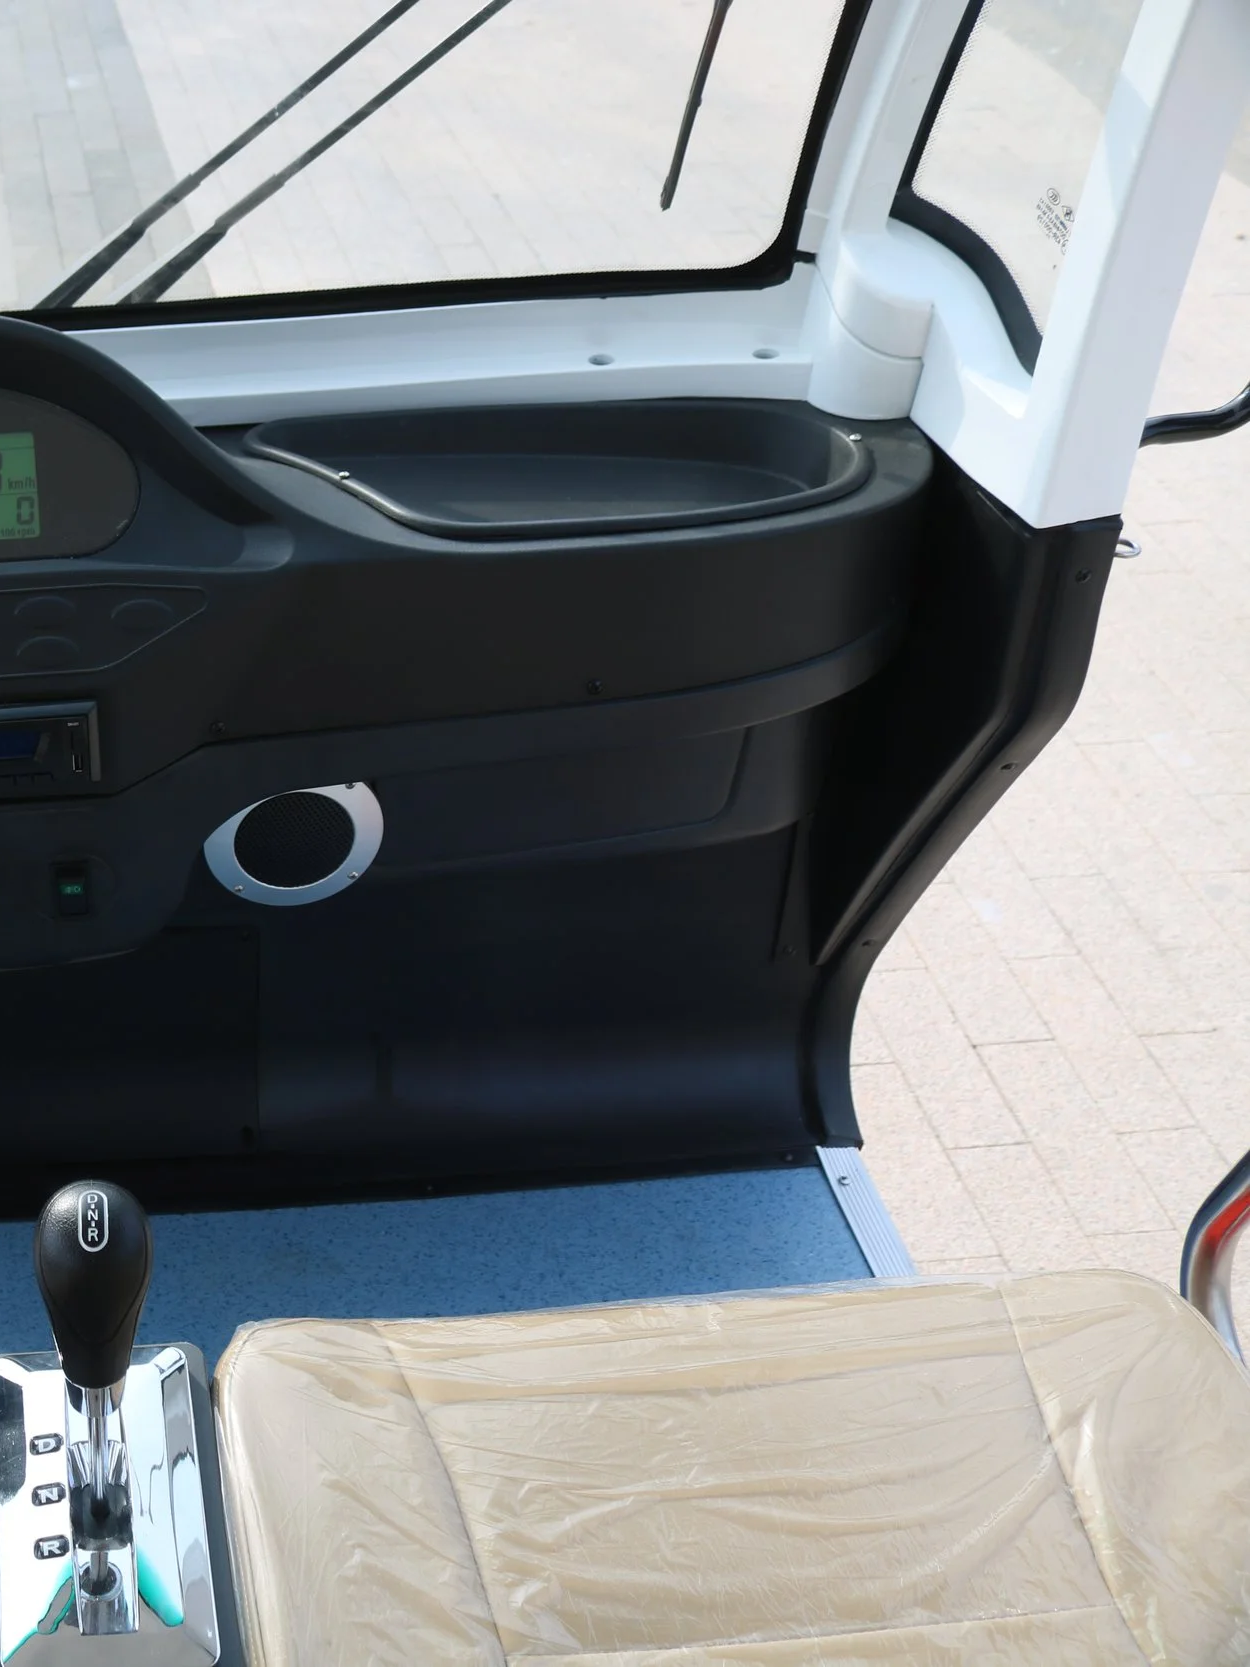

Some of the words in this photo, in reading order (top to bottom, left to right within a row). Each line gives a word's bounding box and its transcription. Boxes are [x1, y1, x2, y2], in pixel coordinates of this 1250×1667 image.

[7, 475, 36, 491] km/h
[16, 496, 35, 525] 0
[87, 1193, 99, 1205] D
[87, 1209, 99, 1221] N
[87, 1227, 99, 1242] R
[37, 1436, 57, 1453] D
[39, 1487, 60, 1504] N
[41, 1539, 62, 1556] R
